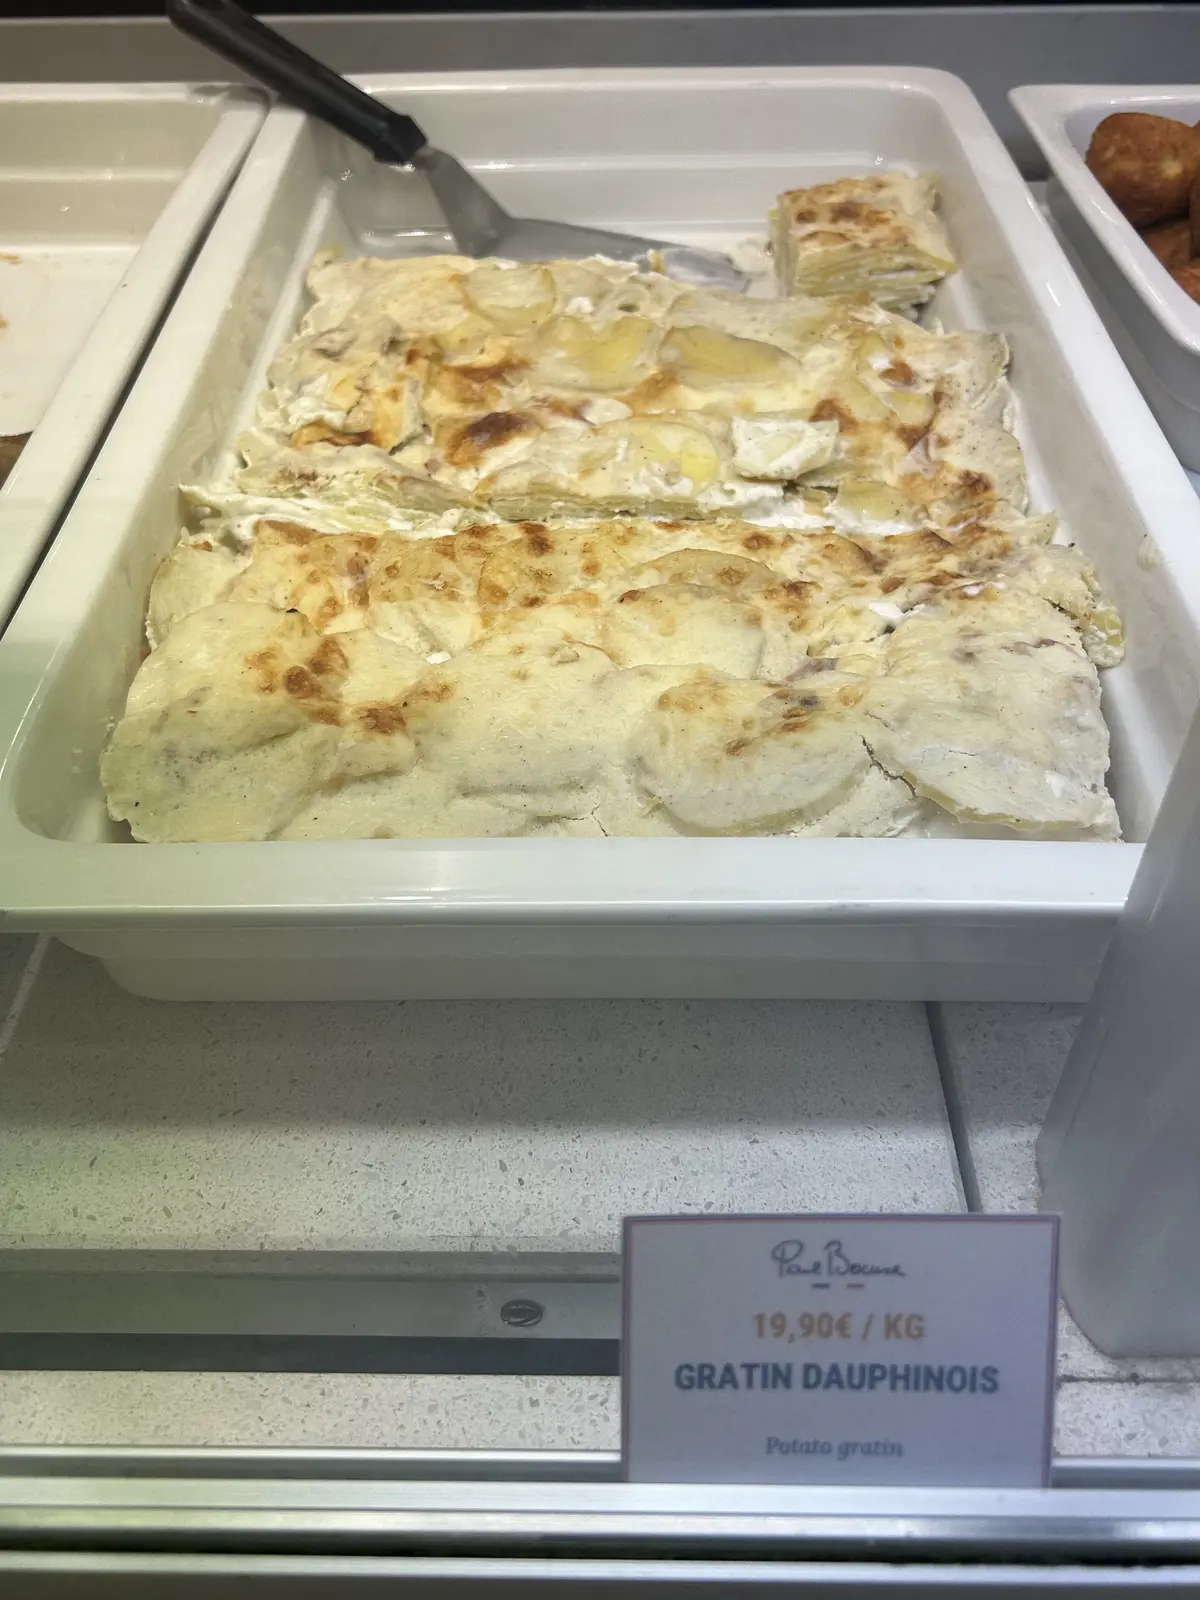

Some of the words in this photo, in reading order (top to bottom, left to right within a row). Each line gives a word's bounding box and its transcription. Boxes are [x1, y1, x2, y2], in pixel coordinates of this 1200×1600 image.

[771, 1240, 821, 1278] Paul
[753, 1312, 852, 1343] 19,90€
[861, 1313, 873, 1341] /
[884, 1313, 926, 1340] KG
[674, 1363, 793, 1391] GRATIN
[803, 1364, 1000, 1394] DAUPHINOIS
[765, 1436, 833, 1456] Potato
[838, 1436, 905, 1461] gratin
